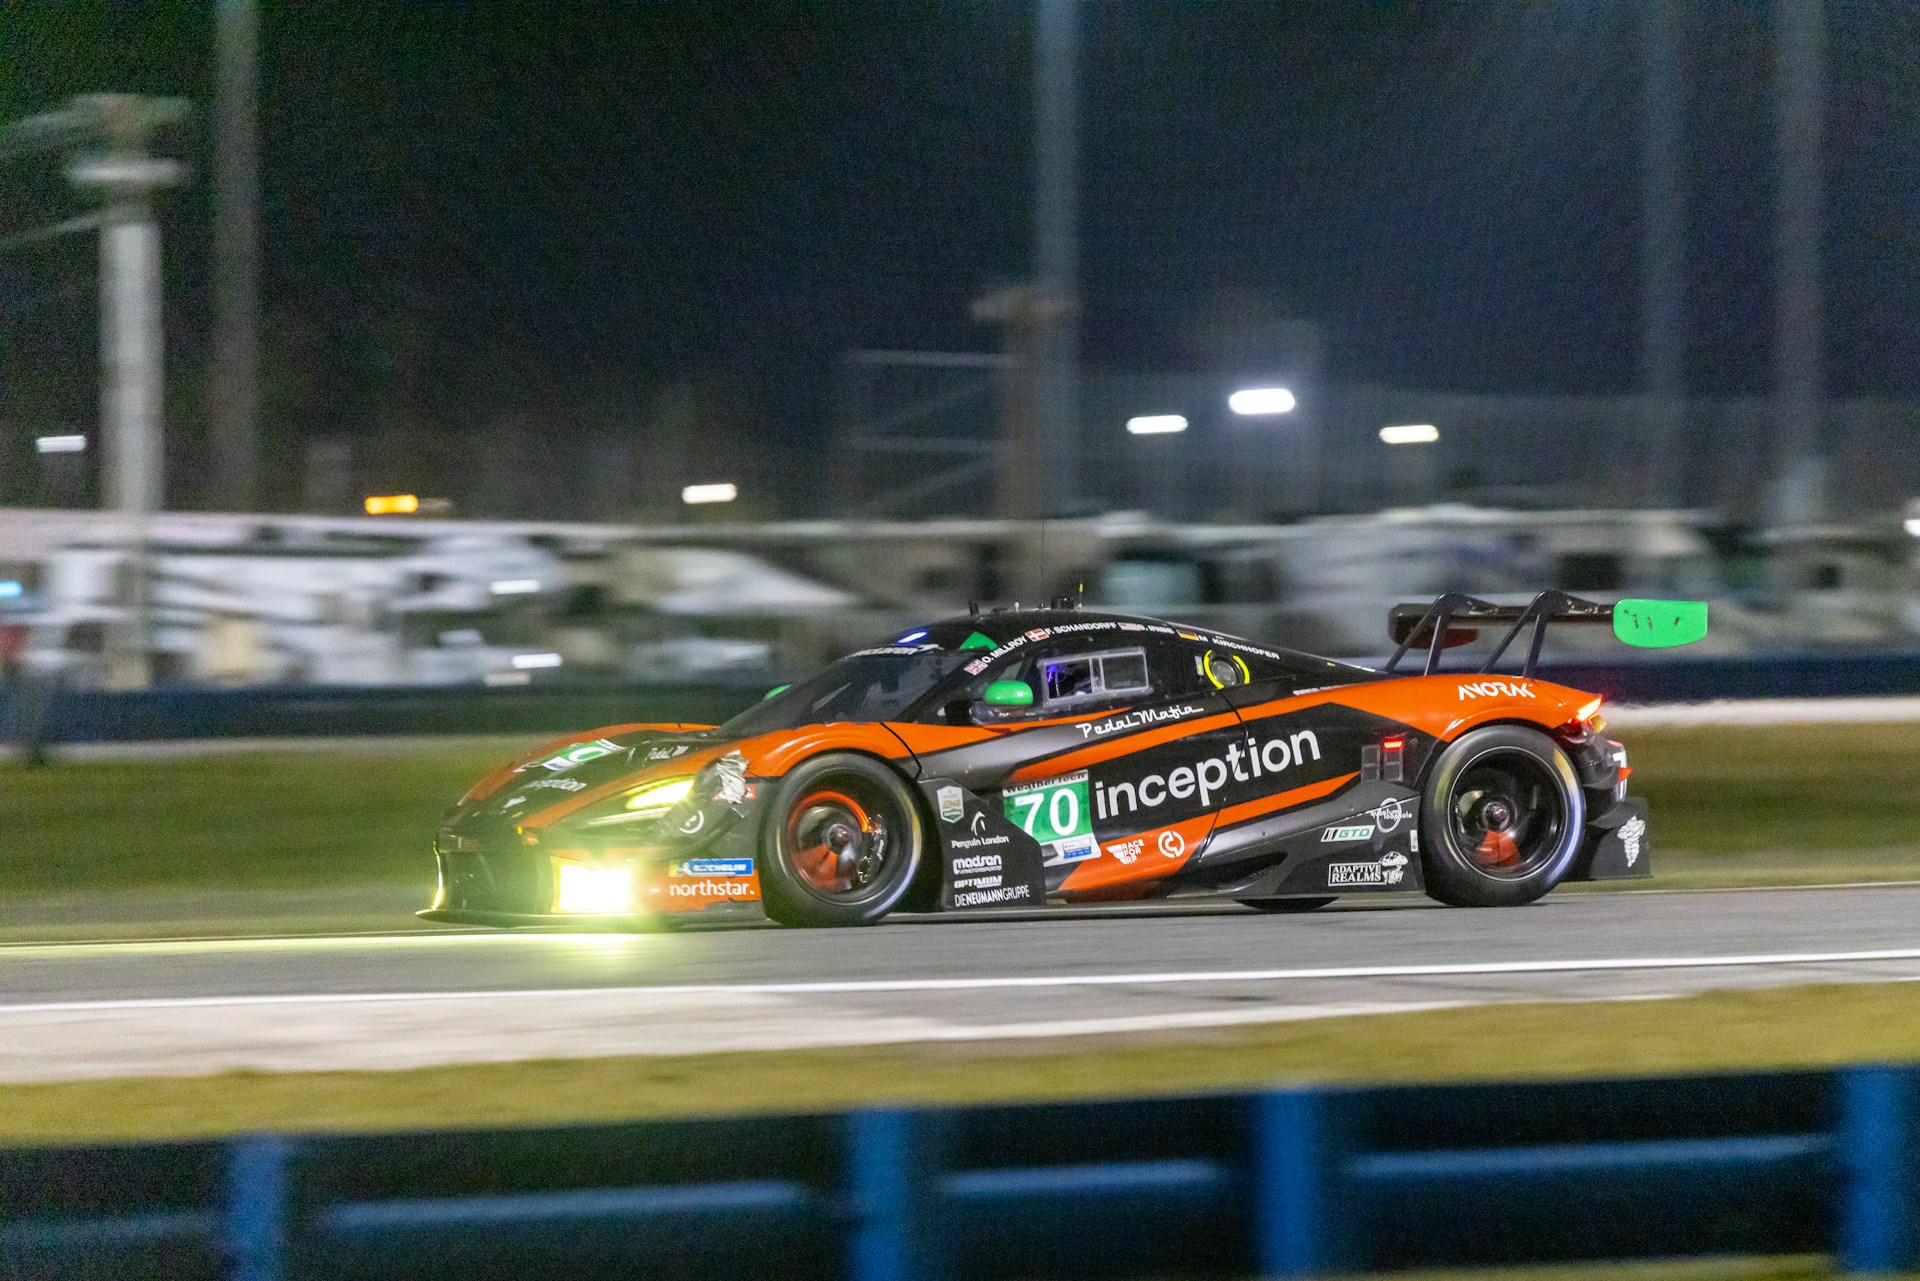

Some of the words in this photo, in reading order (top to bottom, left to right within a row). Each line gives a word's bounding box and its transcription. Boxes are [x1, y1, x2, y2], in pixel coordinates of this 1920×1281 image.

[1211, 637, 1280, 660] KIRCHHOFER
[1095, 729, 1321, 820] inception
[1015, 787, 1079, 837] 70
[951, 837, 982, 849] Penguin
[981, 835, 1010, 846] London
[1331, 871, 1382, 882] REALMS
[1333, 864, 1381, 874] ADAPTIVE
